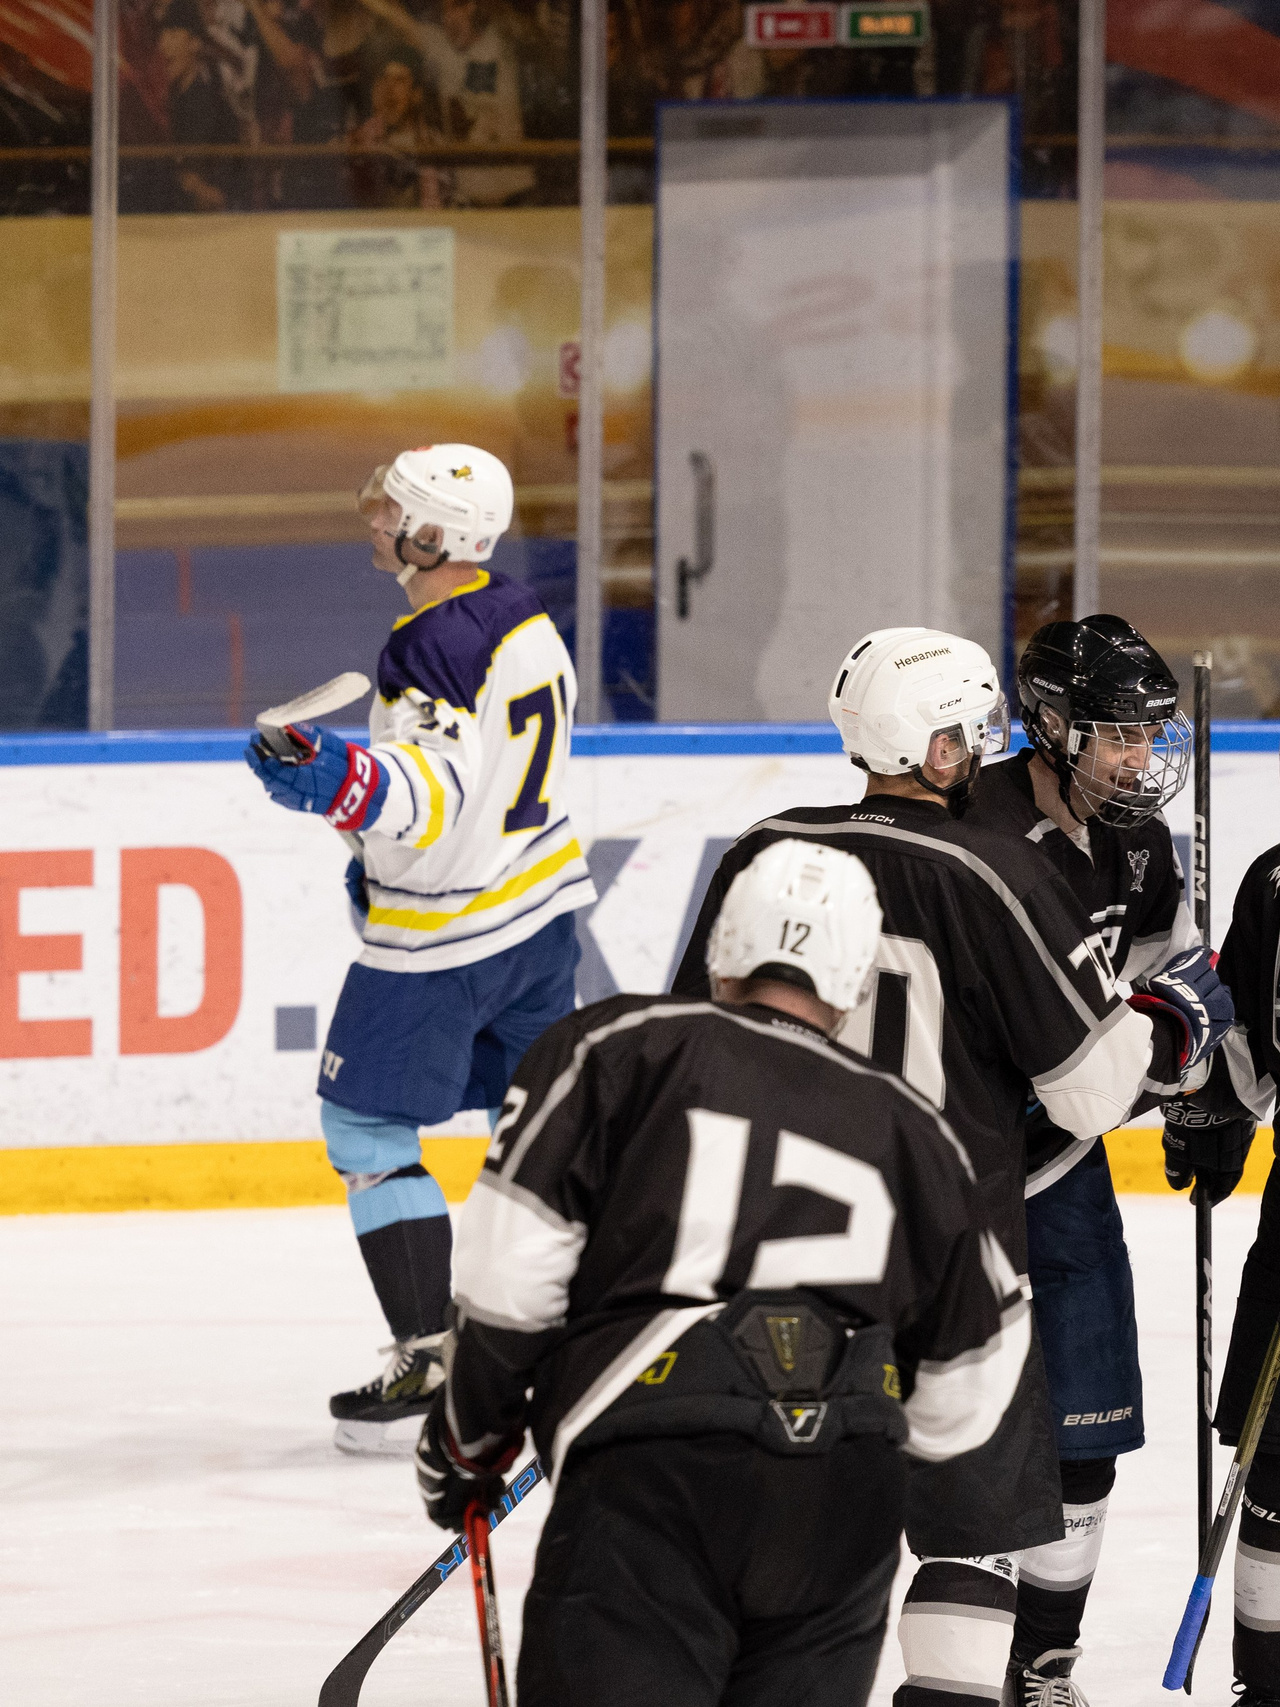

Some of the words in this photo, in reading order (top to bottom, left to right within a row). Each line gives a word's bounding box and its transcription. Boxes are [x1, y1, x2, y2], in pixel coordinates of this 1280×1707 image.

[894, 647, 952, 670] Невалинк
[1032, 676, 1065, 694] BAUER
[939, 697, 962, 710] CCM
[1145, 696, 1177, 708] BAUER
[502, 668, 568, 837] 7
[850, 813, 896, 825] LUTCH
[779, 919, 811, 955] 12
[660, 1107, 897, 1301] 12
[1062, 1406, 1133, 1426] BAUER
